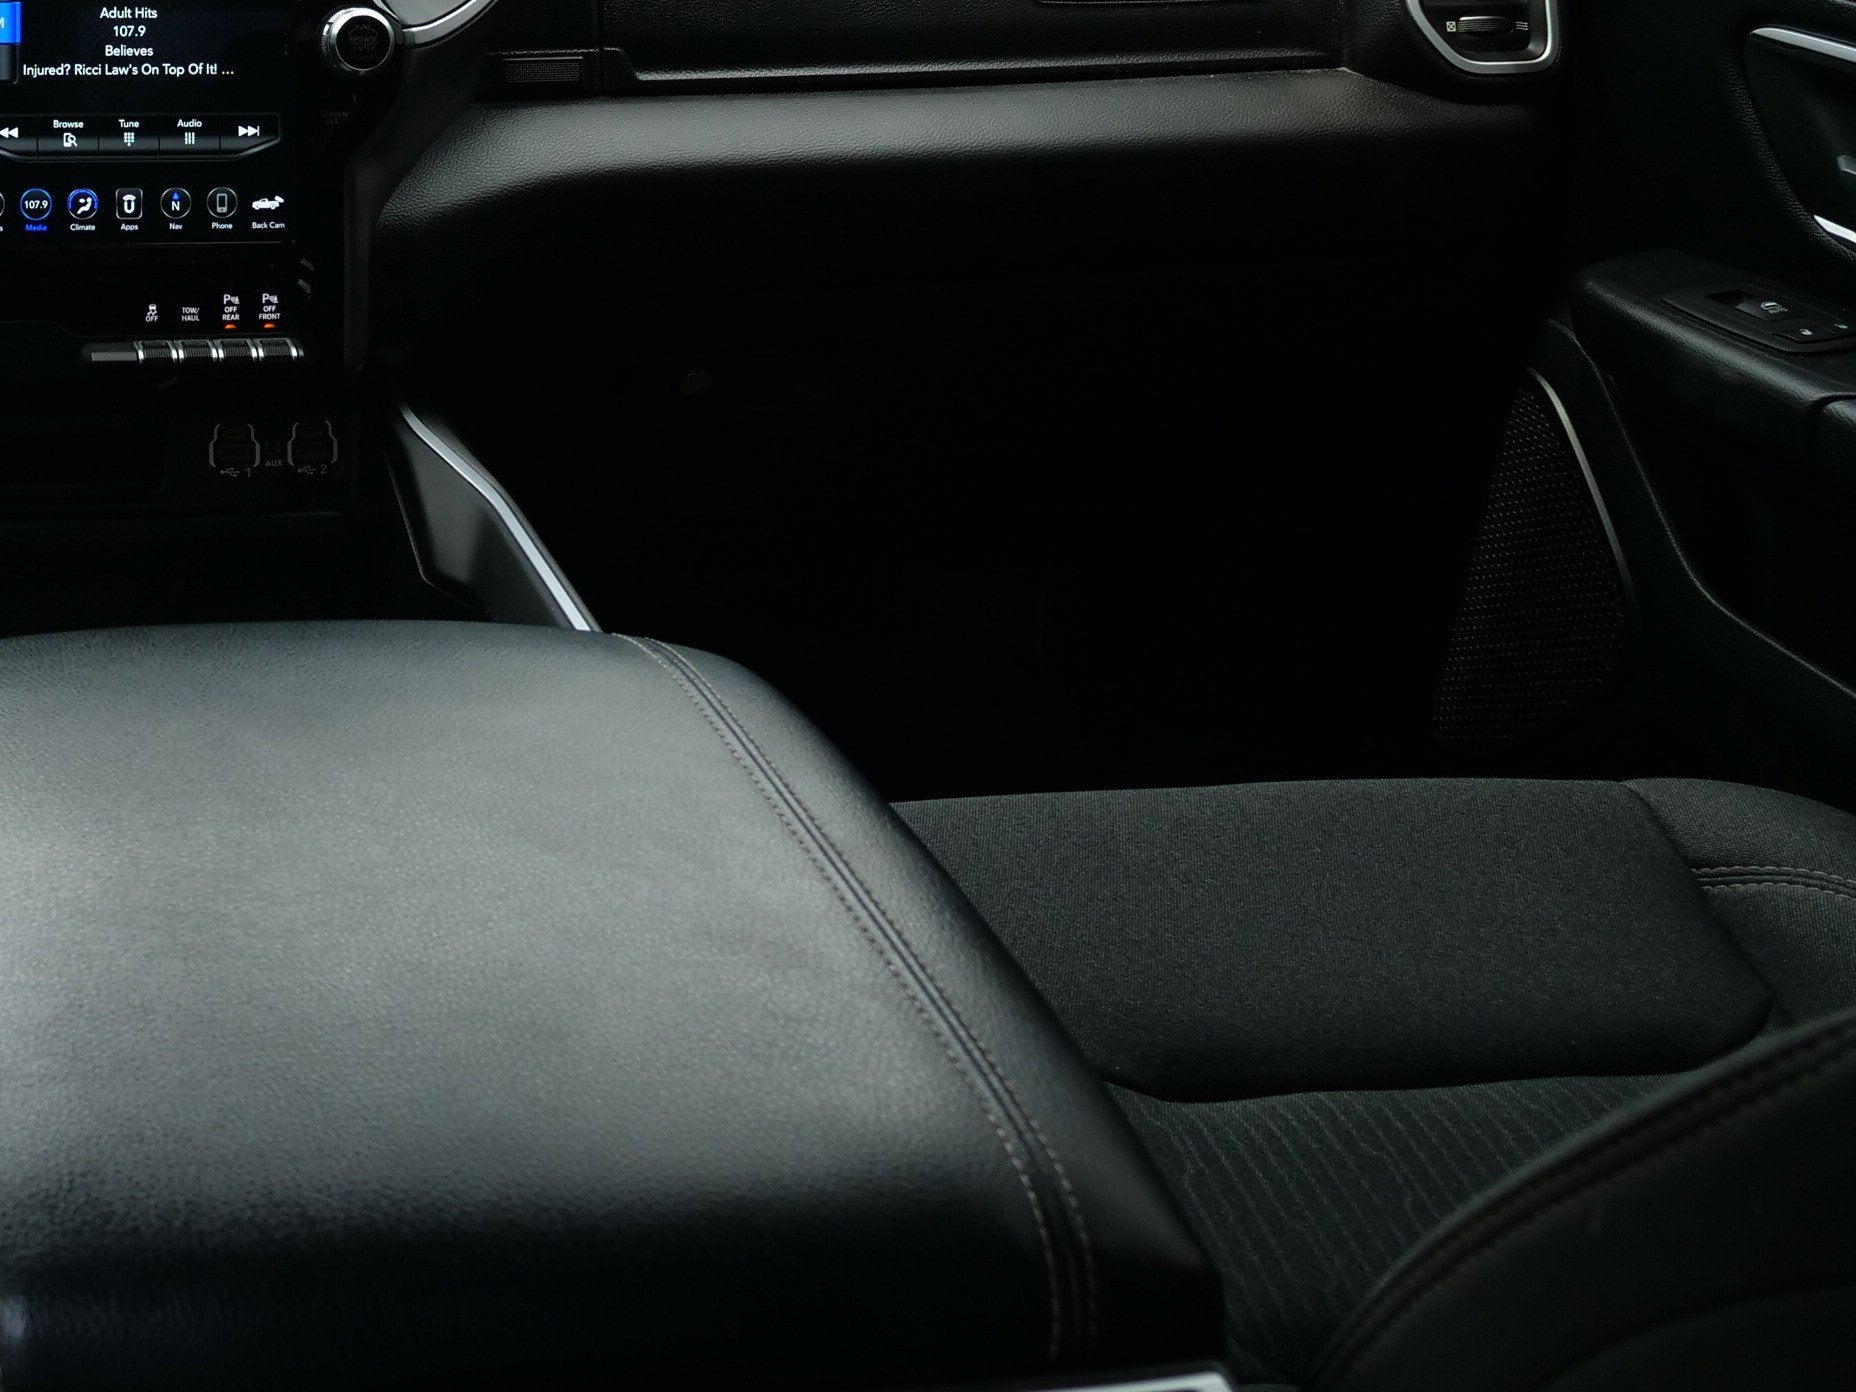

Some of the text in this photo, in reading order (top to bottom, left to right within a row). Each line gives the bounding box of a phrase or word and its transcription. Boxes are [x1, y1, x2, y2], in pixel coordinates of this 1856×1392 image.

[99, 6, 158, 19] Adult Hits
[112, 25, 147, 38] 107.9
[104, 44, 154, 57] Believes
[22, 63, 72, 78] Injured?
[74, 63, 102, 76] Ricci
[104, 63, 139, 76] Law's
[141, 63, 160, 76] On
[161, 63, 185, 78] Top
[187, 62, 204, 75] Of
[52, 119, 84, 129] Browse
[117, 118, 141, 128] Tune
[176, 118, 203, 128] Audio
[23, 199, 49, 210] 107.9
[171, 200, 181, 211] N
[25, 223, 48, 232] Media
[69, 222, 96, 232] Climate
[120, 222, 140, 232] Apps
[169, 222, 184, 231] Nav
[211, 221, 234, 230] Phone
[251, 221, 286, 230] Back Cam
[224, 305, 238, 314] OFF
[262, 304, 277, 313] OFF
[145, 315, 159, 323] OFF
[181, 314, 201, 322] HAUL
[222, 313, 241, 321] REAR
[258, 312, 281, 321] FRONT
[265, 459, 284, 468] AUX
